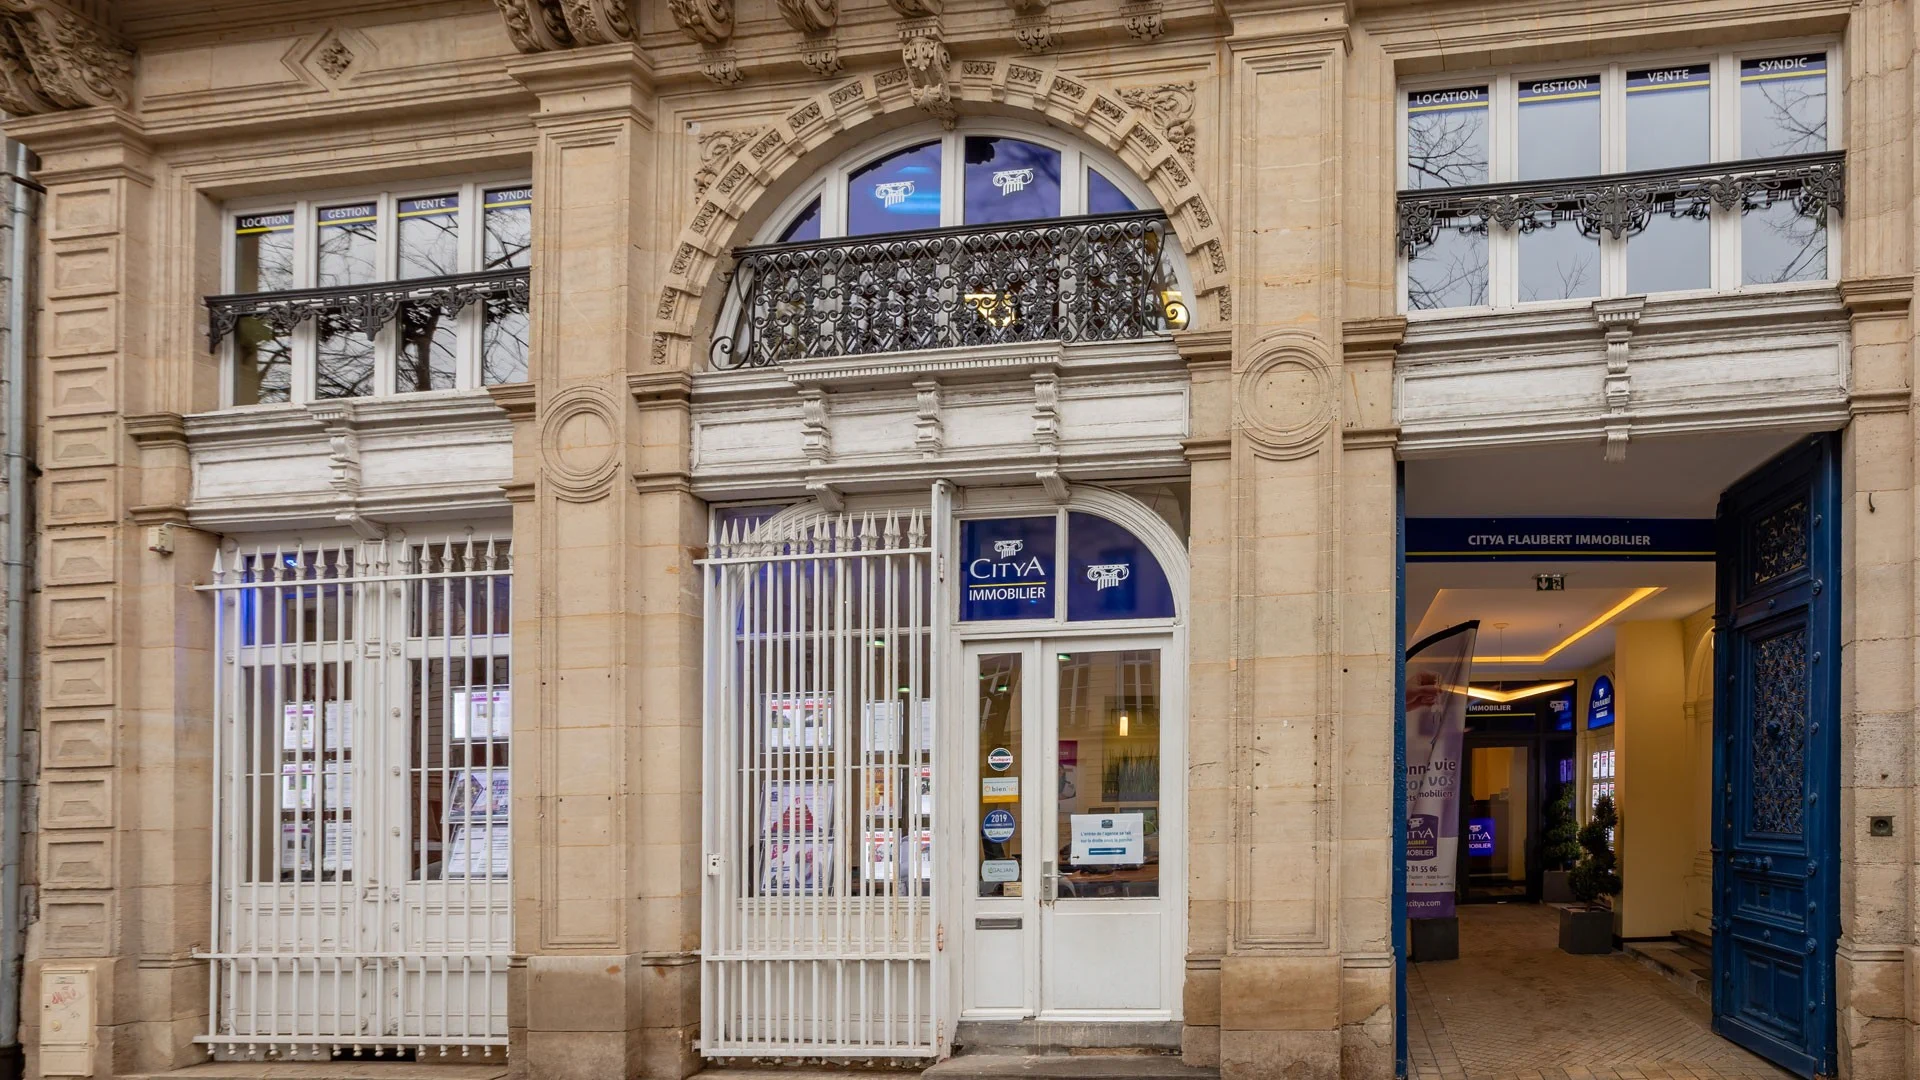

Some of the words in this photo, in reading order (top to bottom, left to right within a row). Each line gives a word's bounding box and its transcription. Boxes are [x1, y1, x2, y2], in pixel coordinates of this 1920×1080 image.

[1759, 57, 1807, 72] SYNDIC
[1647, 70, 1689, 82] VENTE
[1532, 79, 1587, 94] GESTION
[1416, 90, 1479, 105] LOCATION
[414, 198, 446, 210] VENTE
[328, 207, 370, 219] GESTION
[242, 215, 289, 228] LOCATION
[1468, 535, 1504, 545] CITYA
[1507, 534, 1572, 545] FLAUBERT
[1575, 535, 1650, 545] IMMOBILIER
[969, 556, 1045, 579] CITYA
[969, 587, 1045, 601] IMMOBILIER
[1434, 758, 1456, 771] vie
[991, 814, 1008, 823] 2019
[1406, 827, 1434, 839] ITYA
[1468, 832, 1491, 840] ITYA
[1420, 865, 1428, 873] 55
[1406, 900, 1441, 908] .citya.com
